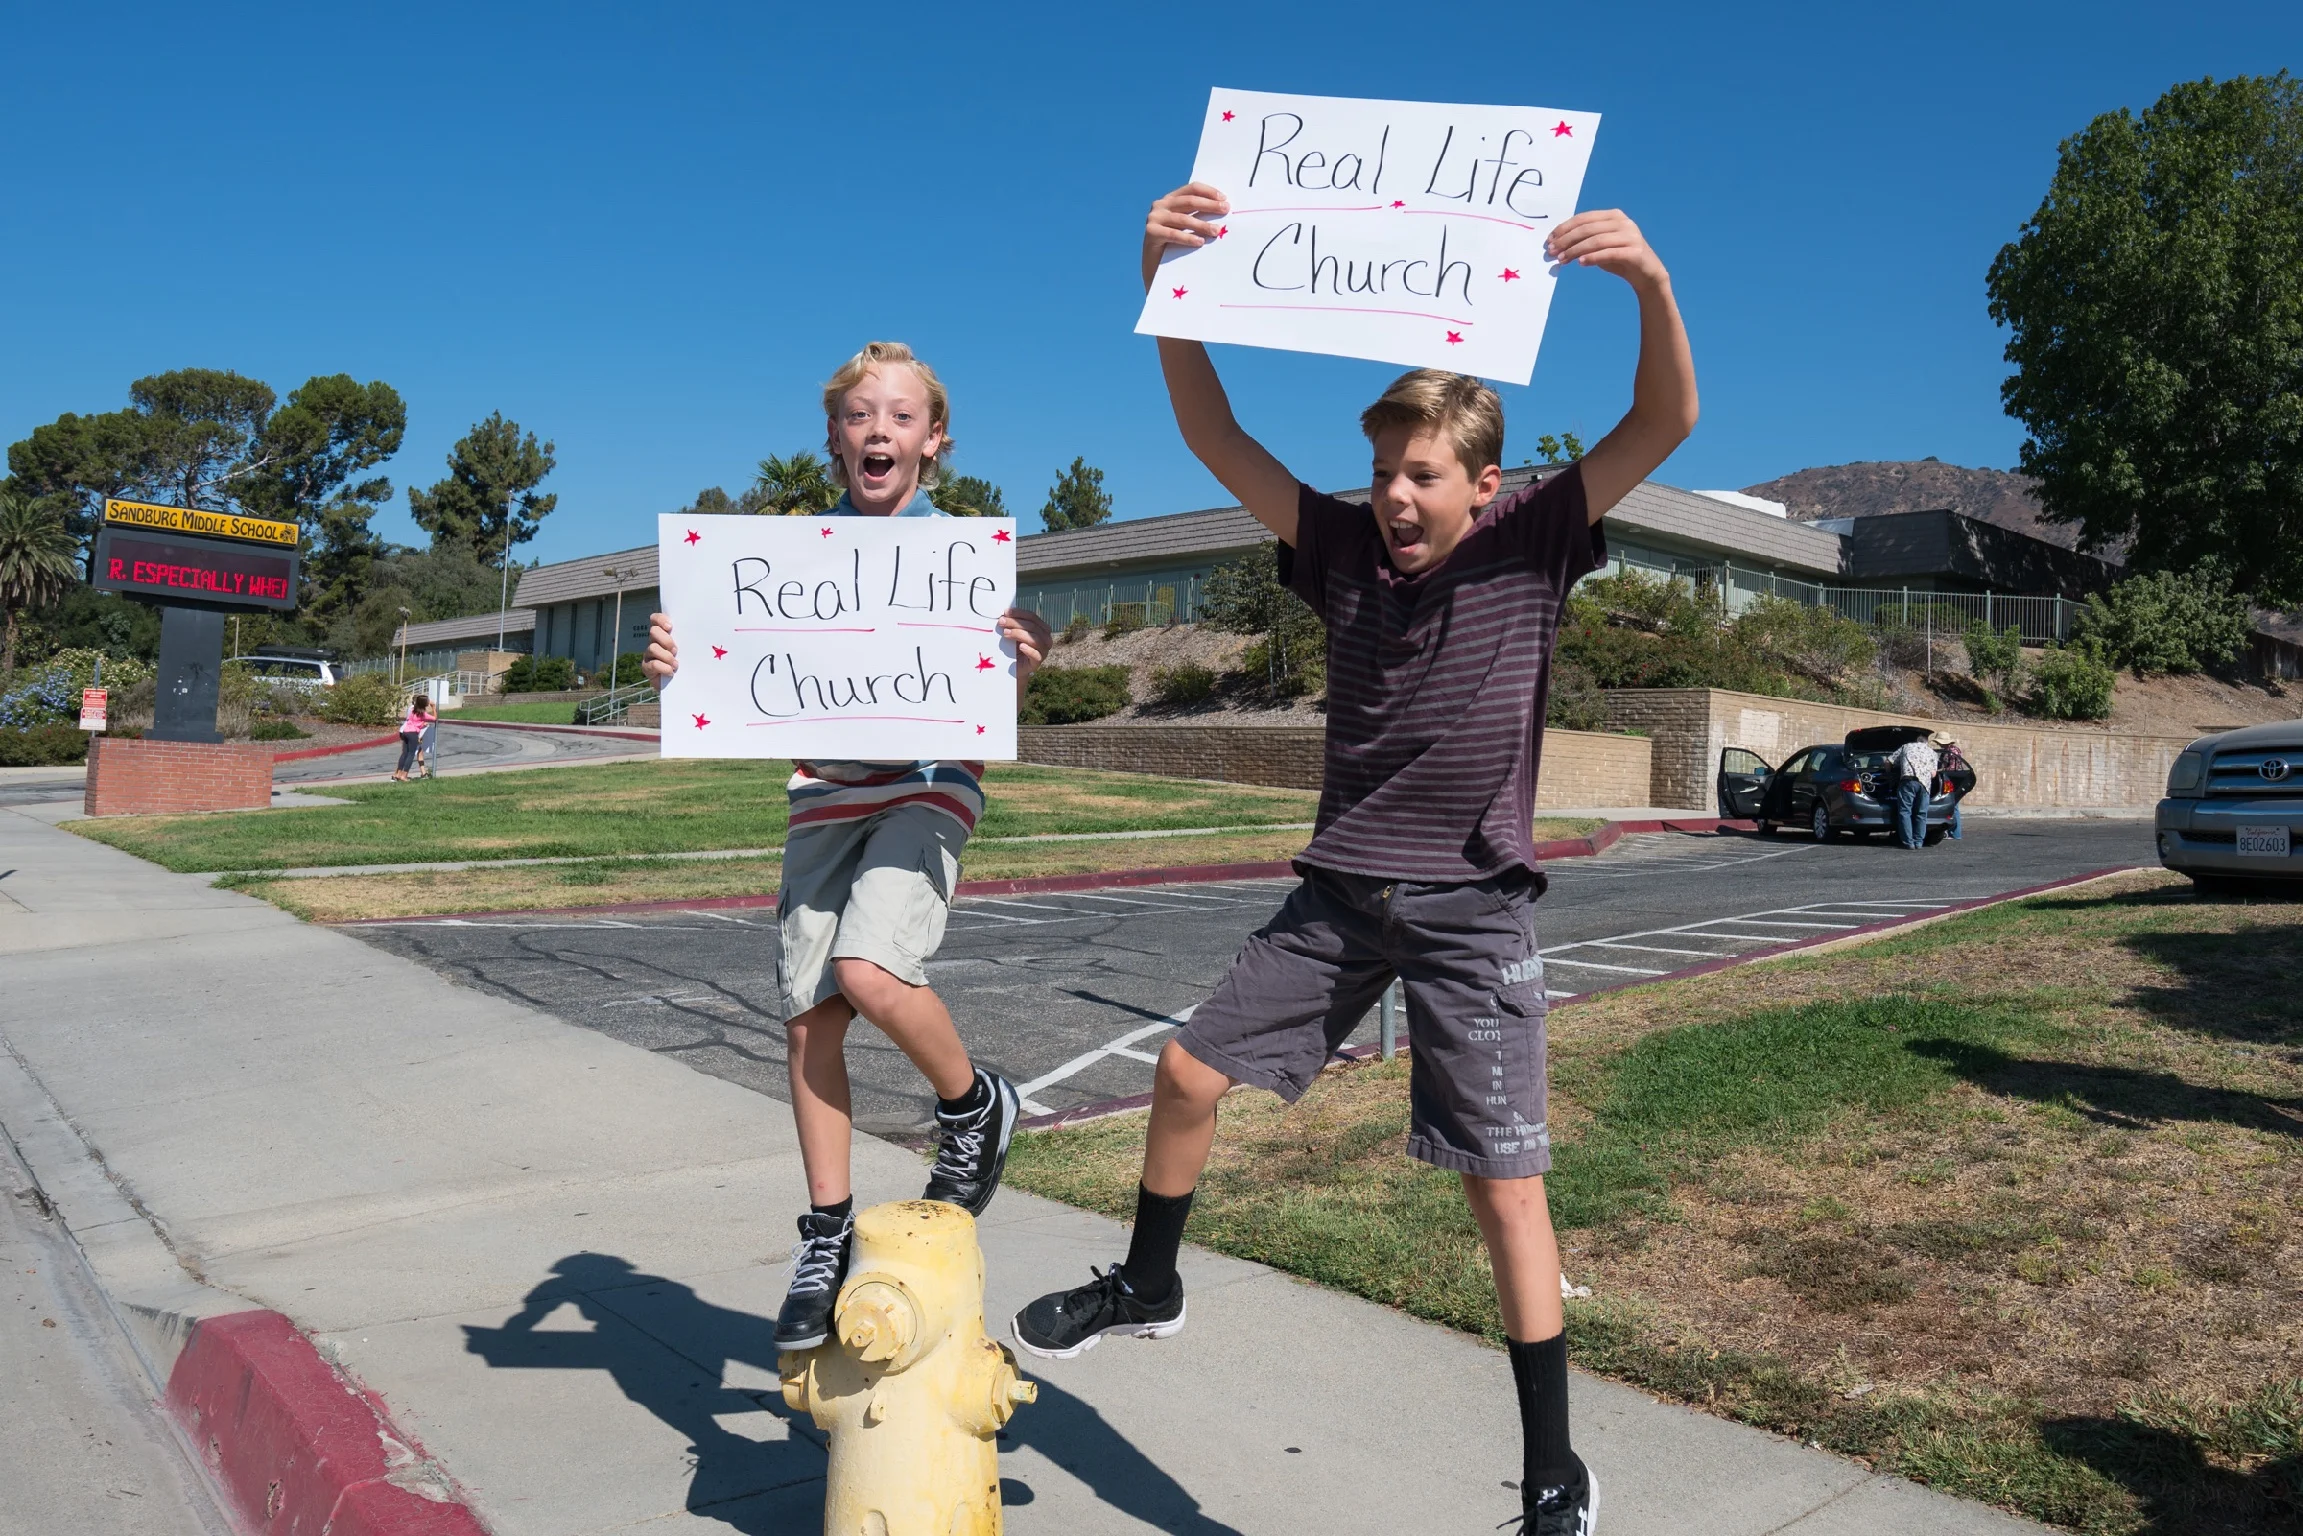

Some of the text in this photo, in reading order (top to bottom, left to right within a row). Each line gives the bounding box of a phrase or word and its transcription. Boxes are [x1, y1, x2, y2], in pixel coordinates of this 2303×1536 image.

[1248, 113, 1549, 219] Real Life
[1252, 222, 1474, 307] Church
[109, 502, 279, 540] SANDBURG MIDDLE SCHOOL
[106, 557, 128, 581] R.
[133, 561, 245, 594] ESPECIALLY
[732, 540, 1005, 621] Real Life
[750, 646, 957, 718] Church
[1486, 1126, 1512, 1138] THE
[1494, 1141, 1521, 1155] USE
